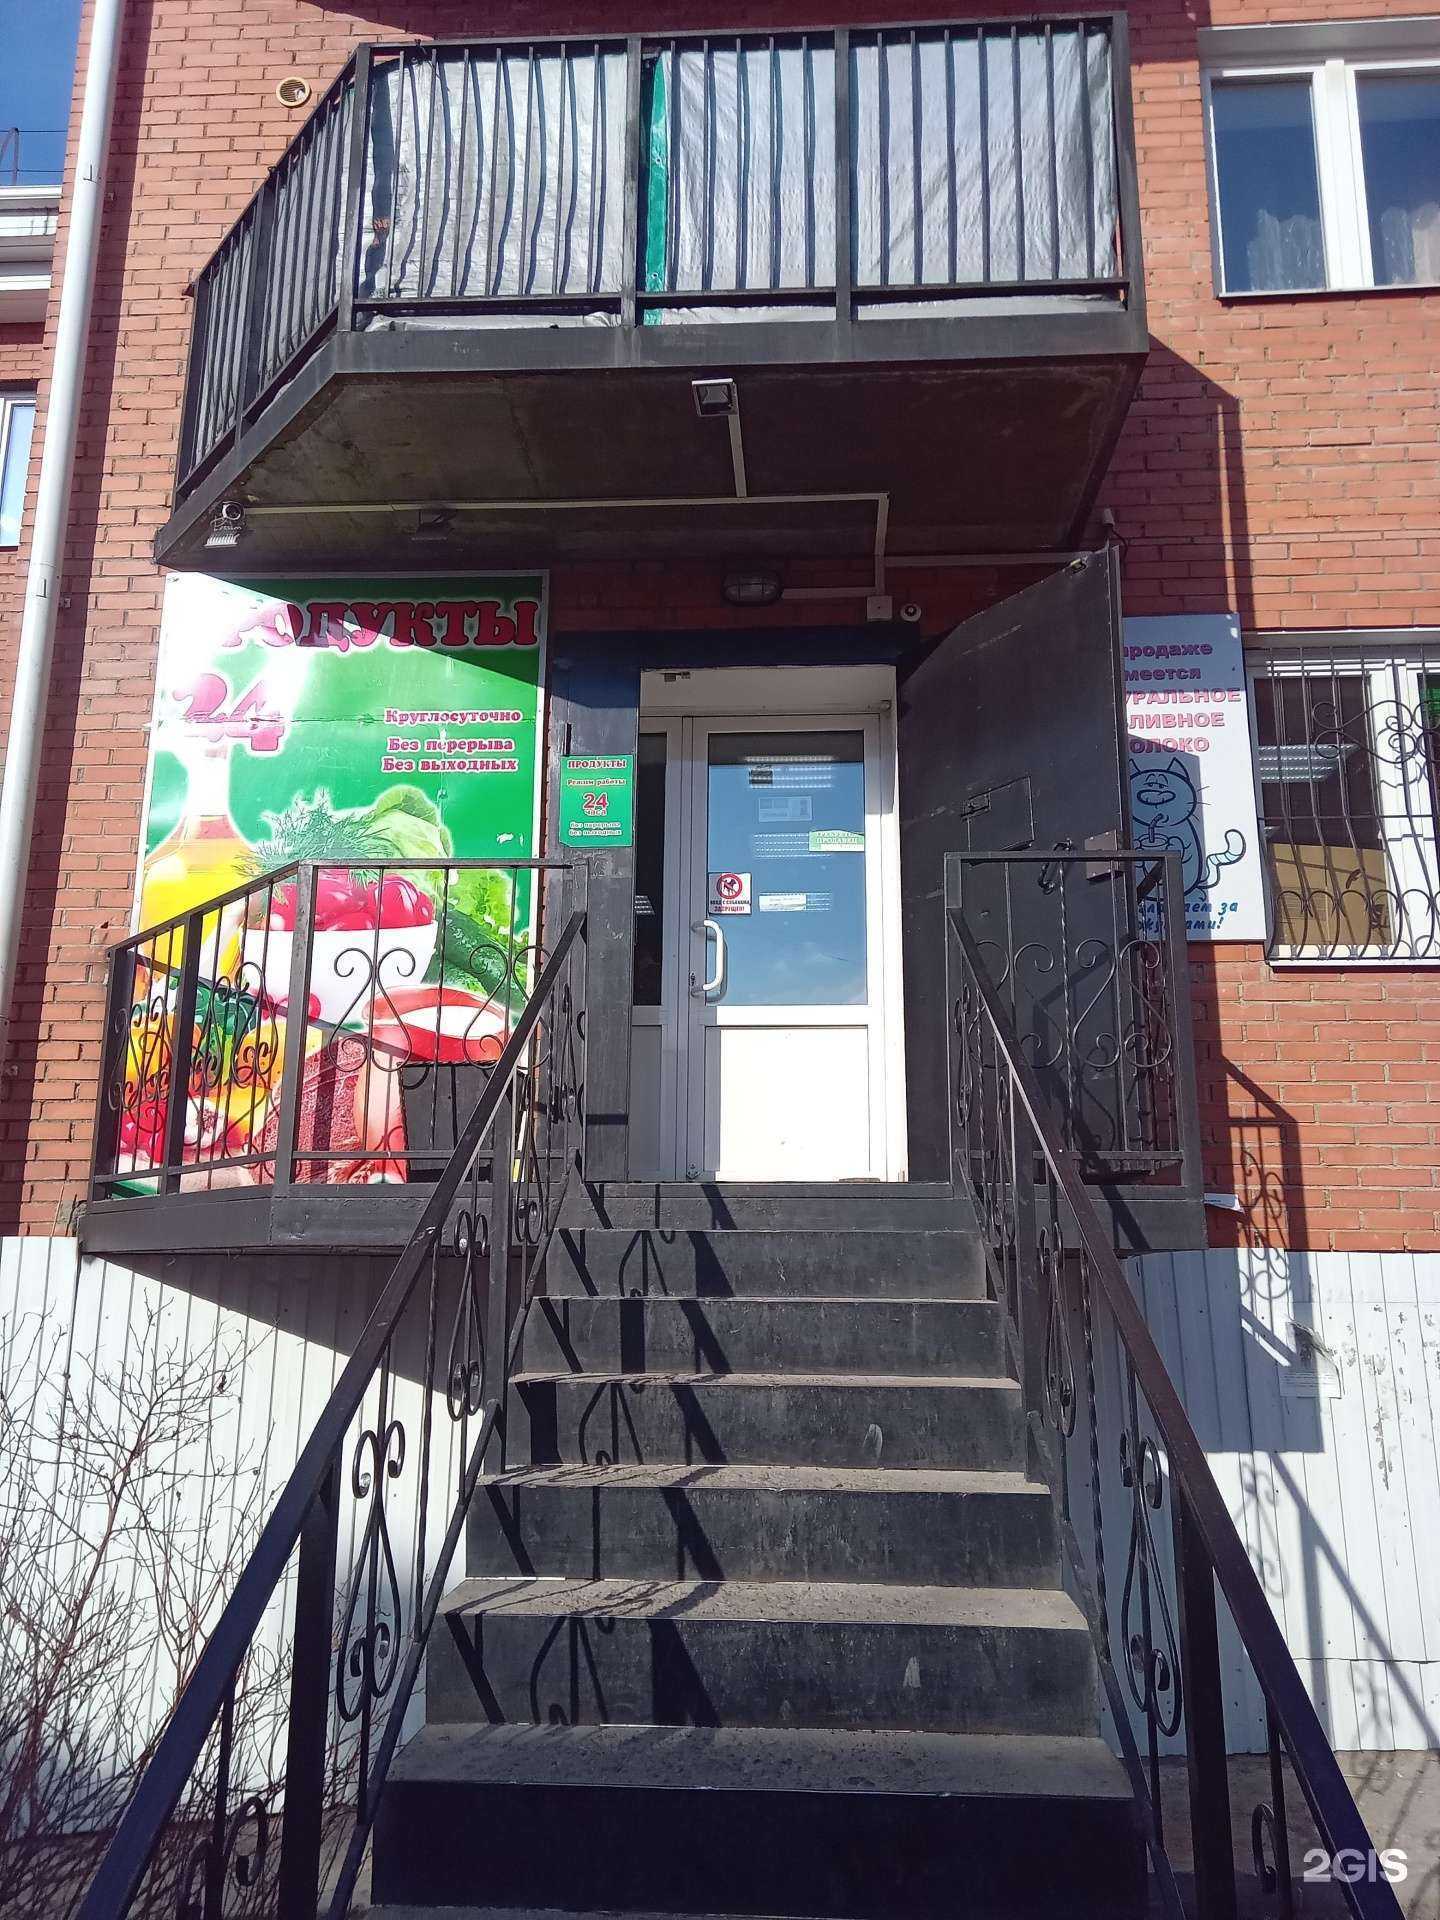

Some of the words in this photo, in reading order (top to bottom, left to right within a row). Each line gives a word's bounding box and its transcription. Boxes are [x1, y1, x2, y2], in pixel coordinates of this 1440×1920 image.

[220, 600, 539, 652] ОДУКТЫ
[1124, 668, 1202, 681] меется
[171, 672, 286, 751] 24
[385, 709, 522, 725] Круглосуточно
[1129, 712, 1225, 729] ЛИВНОЕ
[388, 738, 420, 751] Без
[426, 739, 514, 753] перерыва
[1129, 737, 1210, 753] ОЛОКО
[383, 758, 414, 771] Без
[420, 759, 517, 771] выходных
[568, 760, 626, 768] ПРОДУКТЫ
[597, 778, 625, 786] работы
[583, 793, 608, 809] 24
